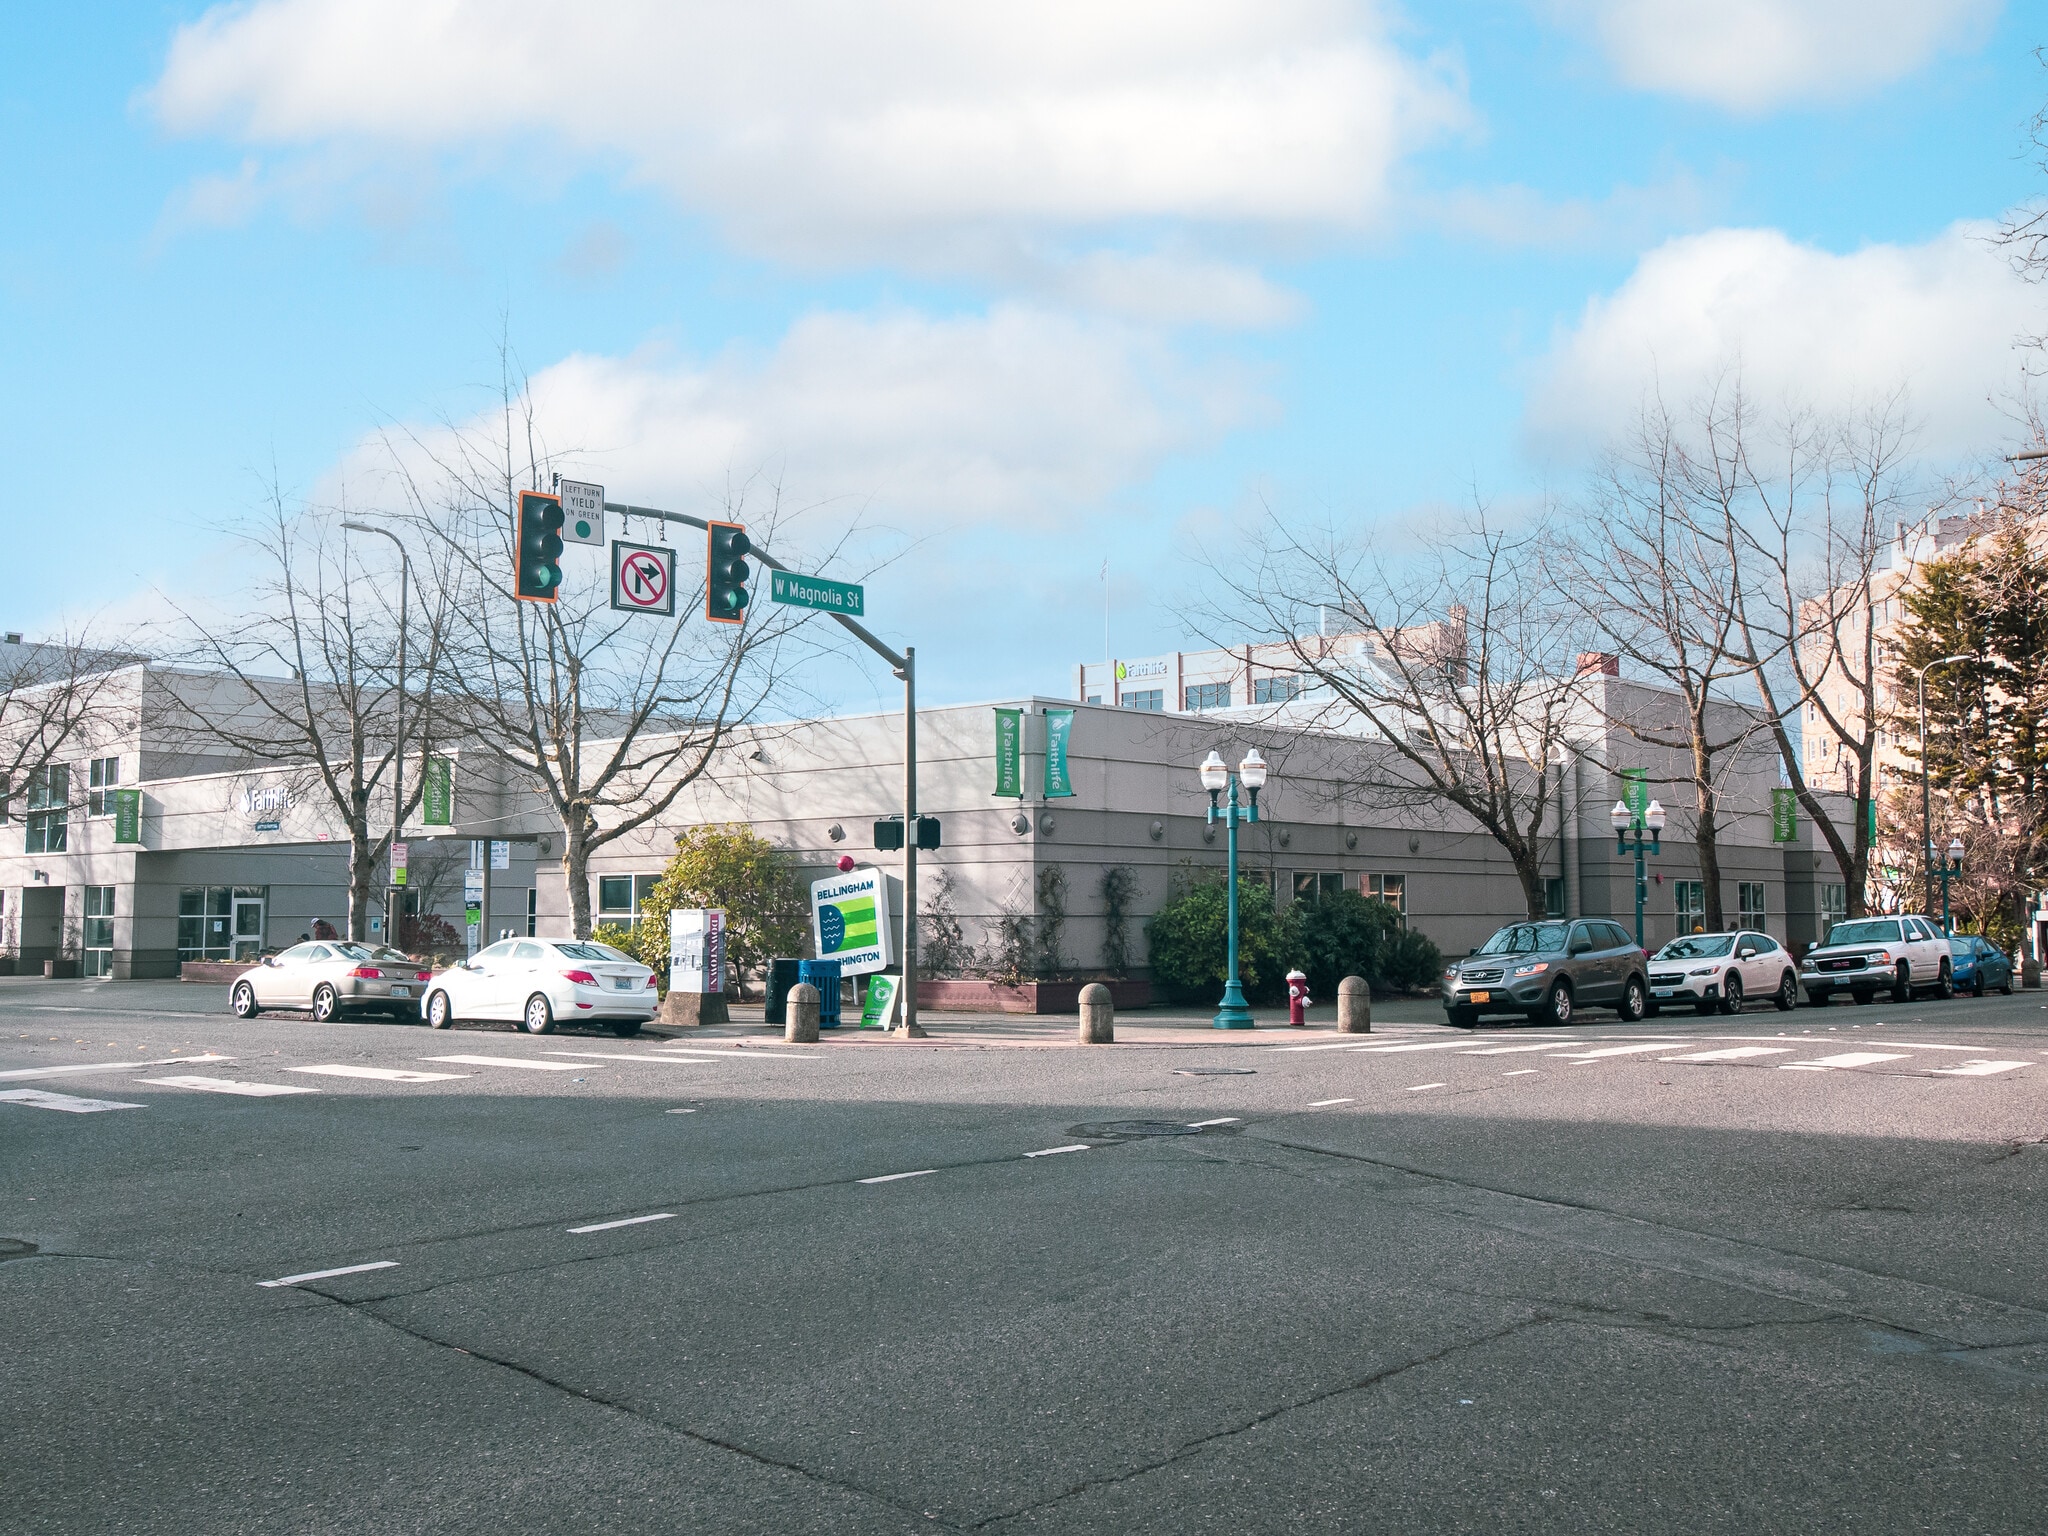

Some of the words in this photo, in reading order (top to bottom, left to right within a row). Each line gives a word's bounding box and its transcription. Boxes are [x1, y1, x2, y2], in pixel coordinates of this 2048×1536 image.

[565, 485, 581, 495] LEFT
[583, 487, 600, 498] TURN
[571, 496, 595, 509] YIELD
[565, 508, 575, 516] ON
[578, 510, 600, 520] GREEN
[775, 578, 785, 596] W
[789, 581, 843, 606] Magnolia
[846, 591, 860, 609] St
[1128, 661, 1168, 677] Faithlife
[1003, 733, 1014, 789] Faithlife
[1050, 733, 1062, 790] Faithlife
[250, 788, 296, 811] Faithlife
[817, 880, 874, 900] BELLINGHAM
[710, 919, 718, 985] DOWNTOWN
[837, 951, 880, 966] HINGTON
